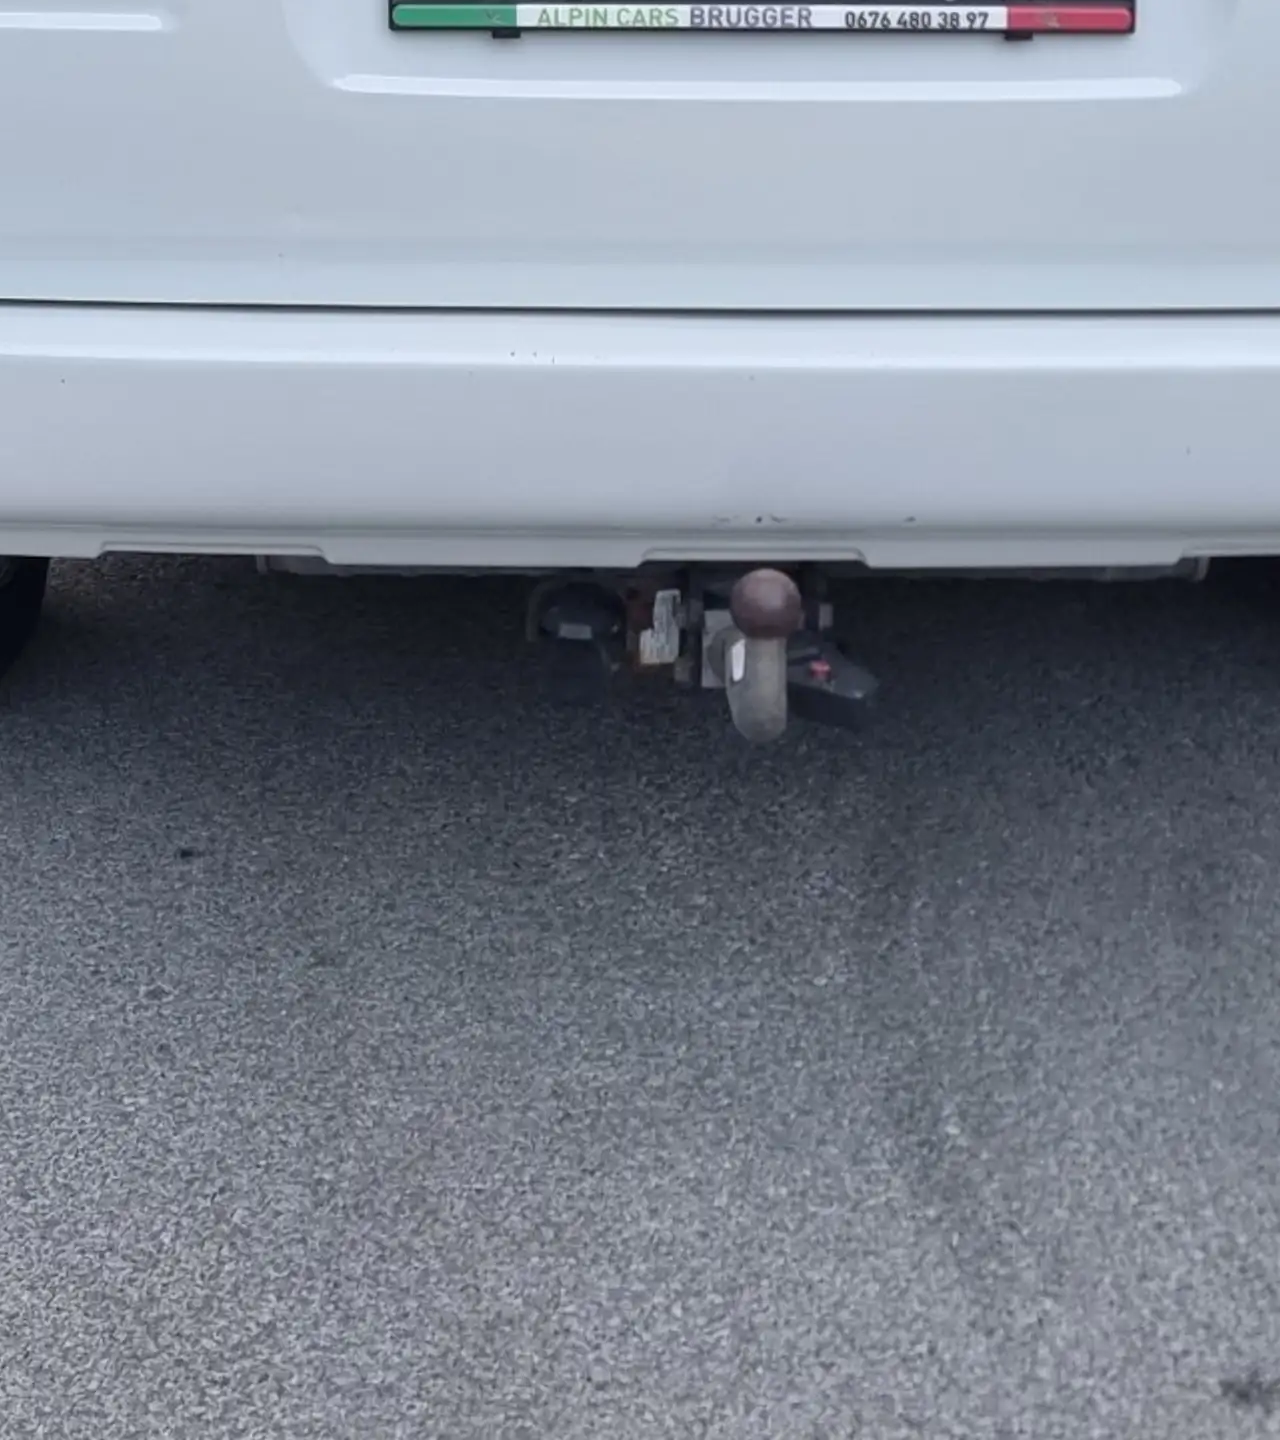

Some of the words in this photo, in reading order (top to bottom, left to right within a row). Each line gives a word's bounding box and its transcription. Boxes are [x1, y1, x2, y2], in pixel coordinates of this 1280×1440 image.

[536, 7, 608, 28] ALPIN
[616, 7, 680, 28] CARS
[689, 6, 813, 28] BRUGGER
[844, 11, 891, 29] 0676
[896, 11, 932, 29] 480
[937, 11, 960, 29] 38
[966, 11, 990, 29] 97
